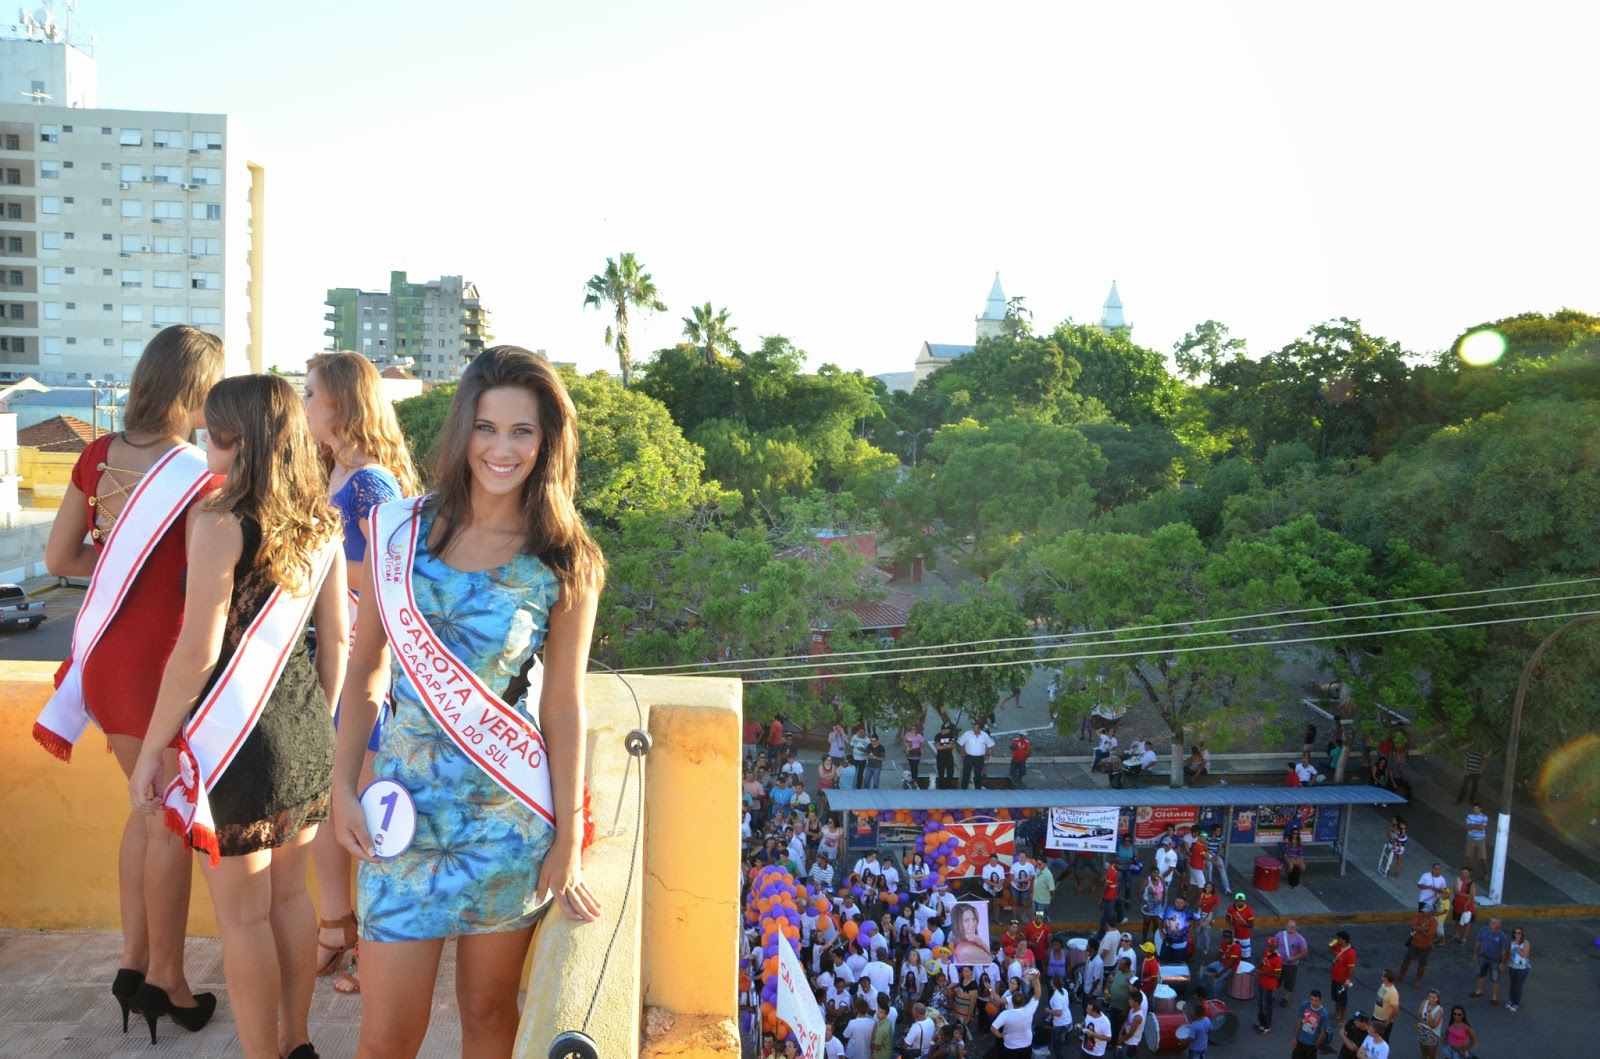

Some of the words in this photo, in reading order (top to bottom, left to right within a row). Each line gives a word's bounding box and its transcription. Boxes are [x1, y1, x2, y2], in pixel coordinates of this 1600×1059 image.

[399, 607, 472, 706] GAROTA
[479, 708, 542, 769] VERÃO
[402, 643, 461, 724] CAÇAPAVA
[461, 725, 484, 745] DO
[485, 744, 509, 769] SUL
[380, 791, 399, 832] 1
